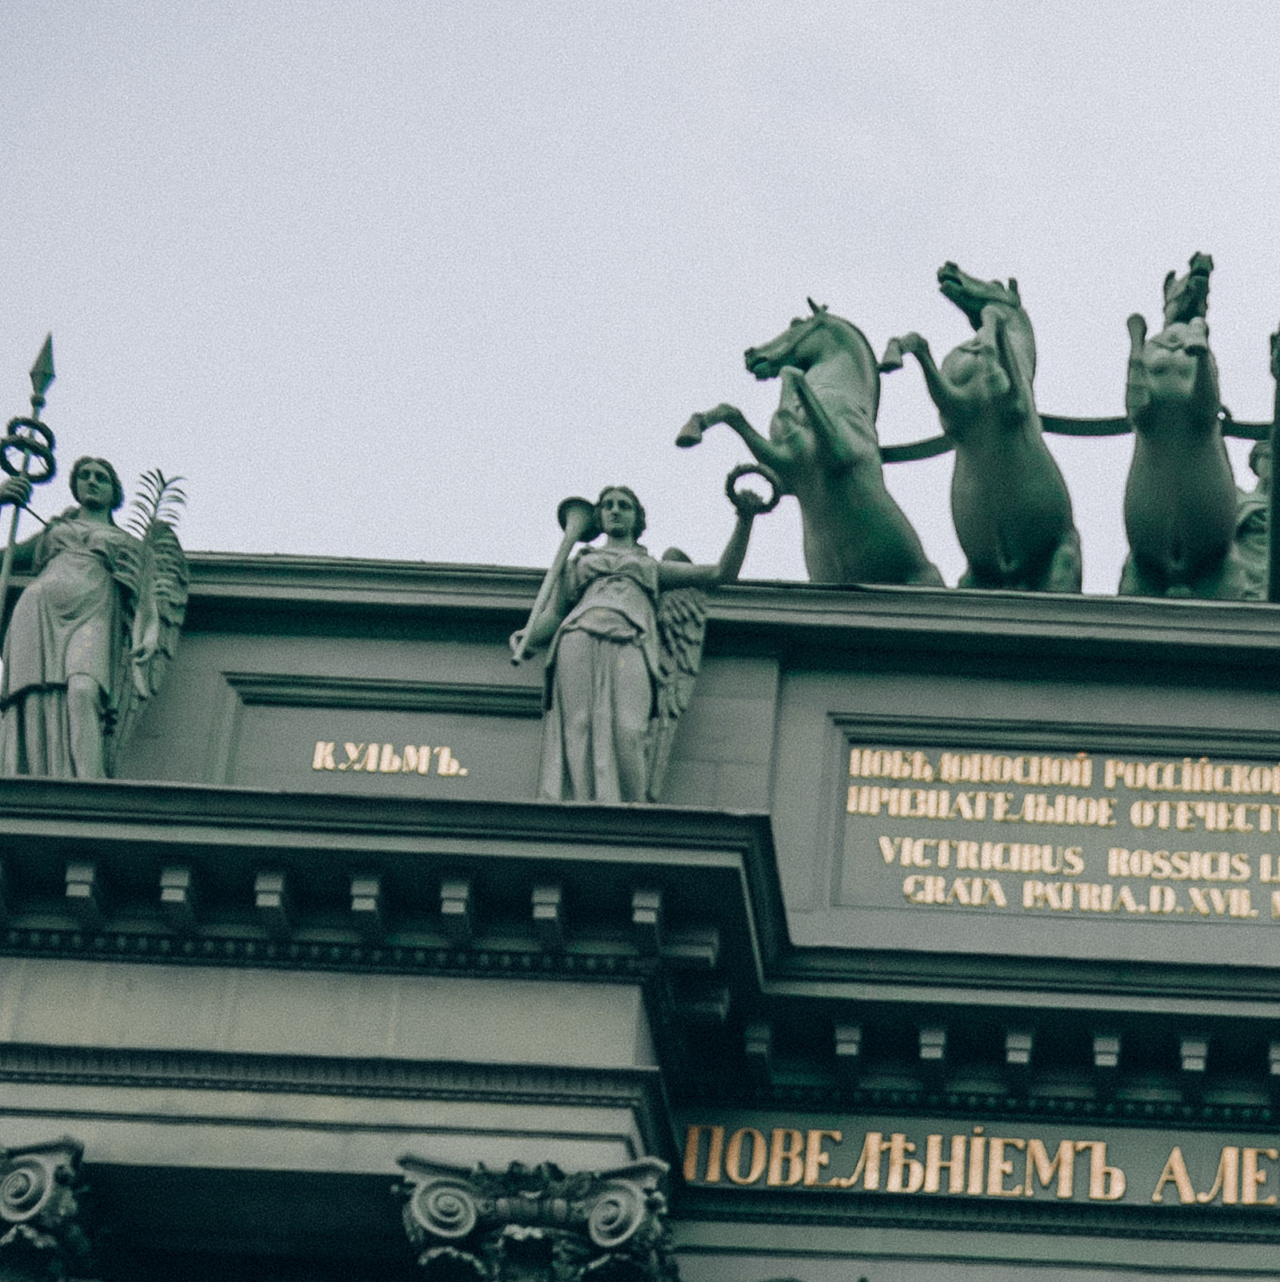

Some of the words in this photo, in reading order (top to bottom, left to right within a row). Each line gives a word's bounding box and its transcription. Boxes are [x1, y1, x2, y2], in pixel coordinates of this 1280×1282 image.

[846, 785, 1118, 827] ПРИЗНАТЕЛЬНОЕ
[878, 835, 1086, 876] VICTRICIBUS
[1107, 846, 1253, 881] ROSSICIS
[902, 874, 1008, 908] GRATA
